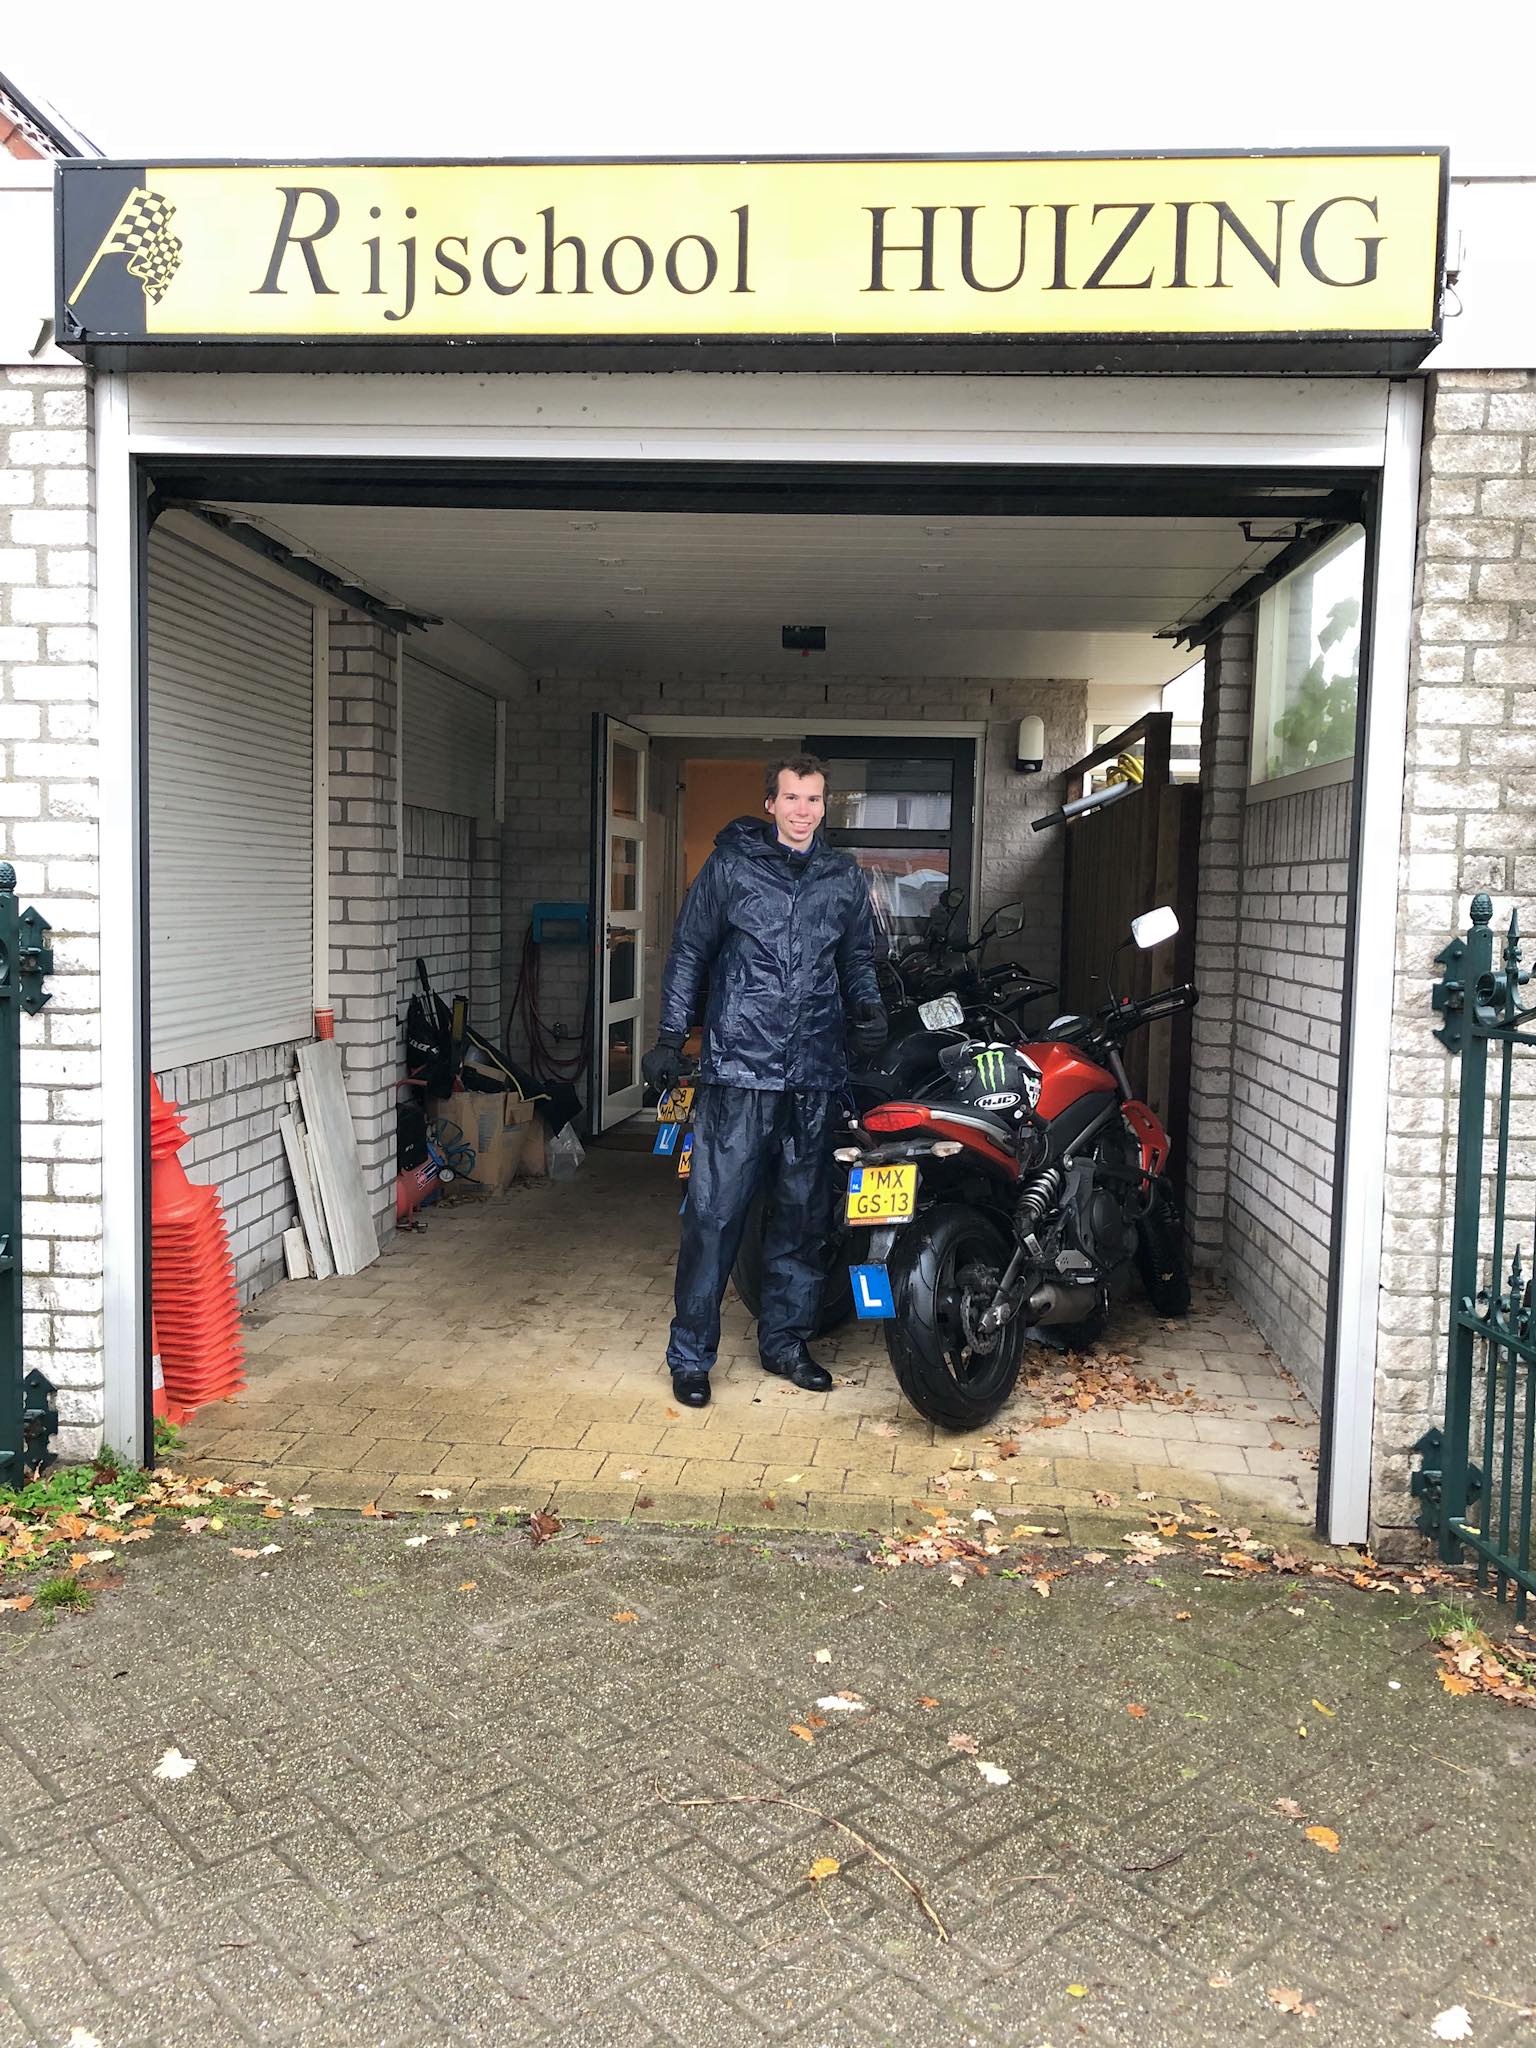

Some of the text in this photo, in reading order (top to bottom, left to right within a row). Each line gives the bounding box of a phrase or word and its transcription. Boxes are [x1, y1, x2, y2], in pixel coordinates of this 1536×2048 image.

[249, 186, 1388, 322] Rijschool HUIZING
[981, 1094, 1013, 1107] HJC
[859, 1274, 883, 1307] L
